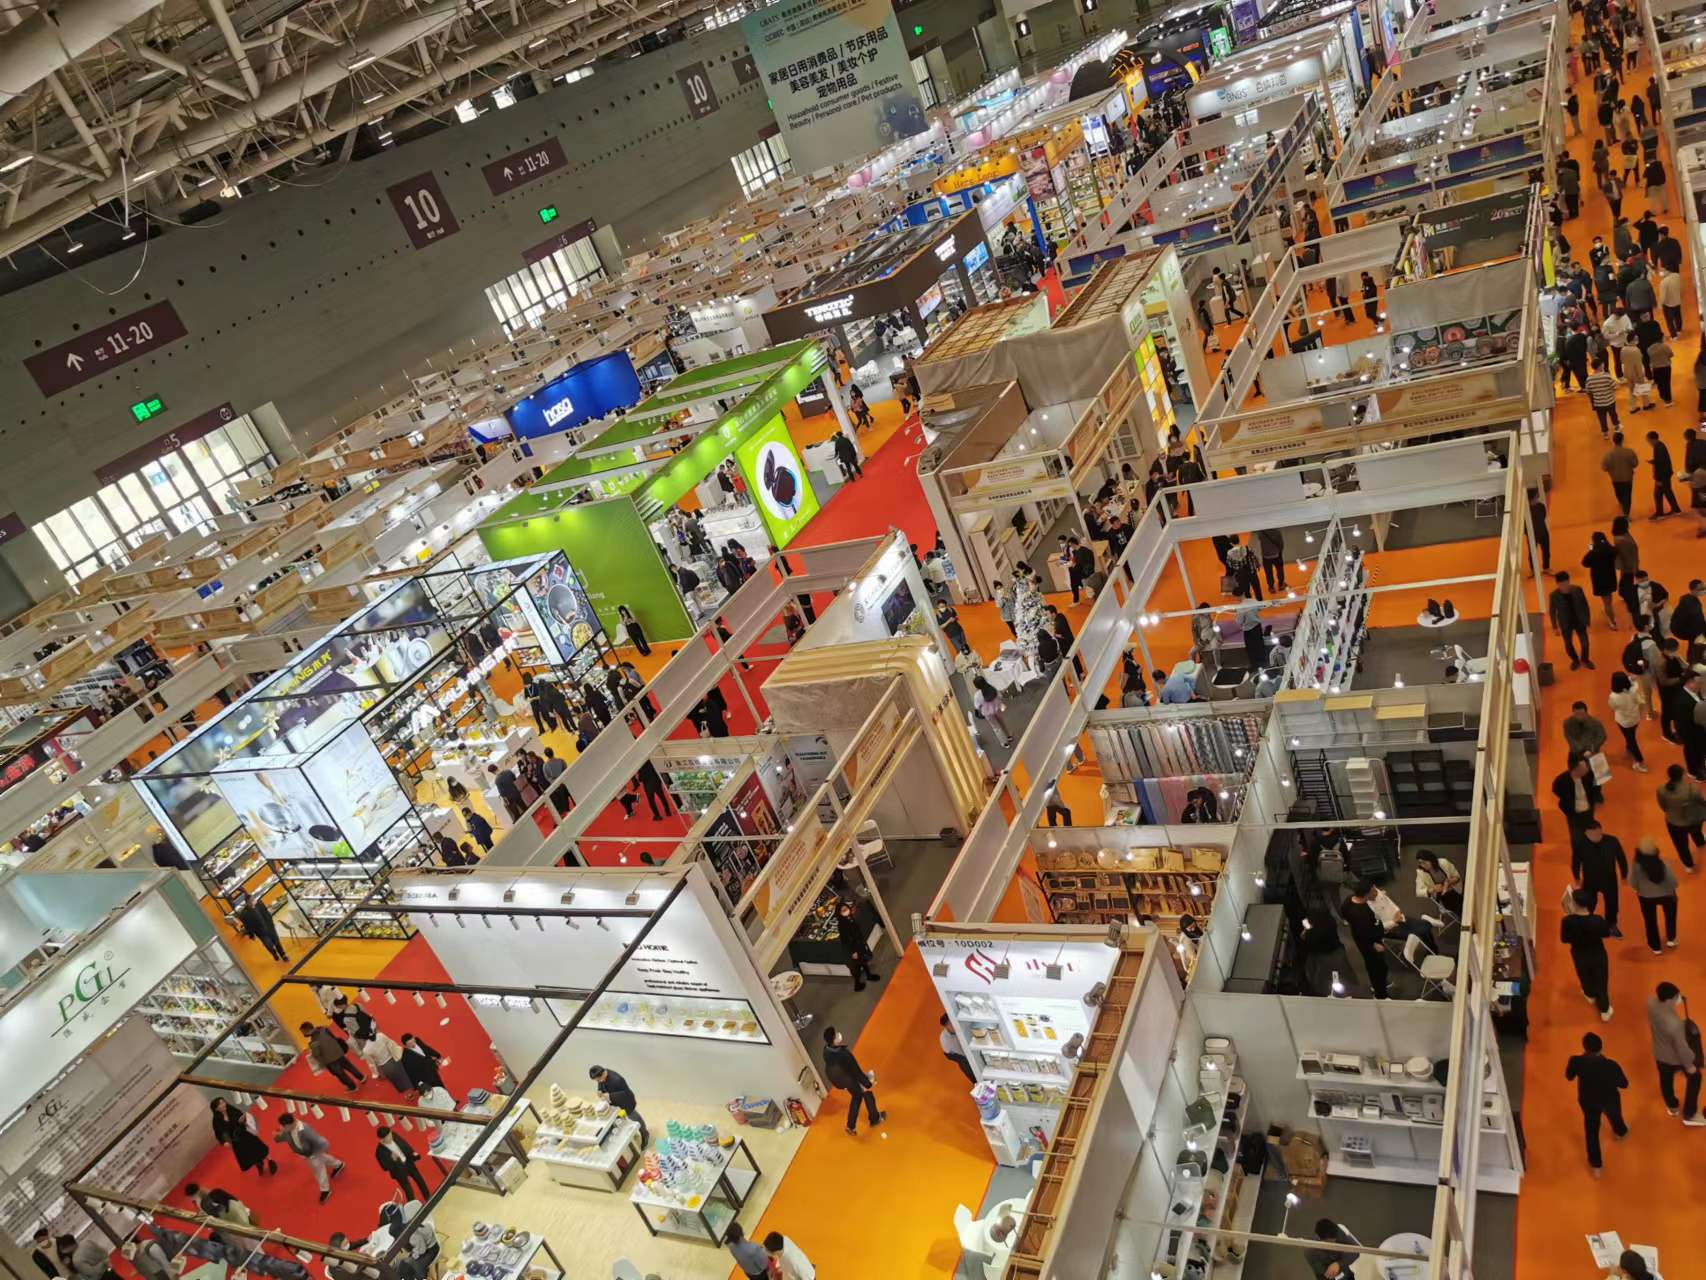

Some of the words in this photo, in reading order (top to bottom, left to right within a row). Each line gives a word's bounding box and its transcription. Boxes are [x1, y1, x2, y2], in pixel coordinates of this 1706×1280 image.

[768, 47, 838, 85] 家居日用消费品
[845, 26, 889, 53] 节庆用品
[789, 68, 830, 94] 美容美发
[838, 47, 878, 74] 美妆个护
[686, 74, 708, 105] 10
[787, 104, 819, 121] Household
[820, 92, 850, 109] consumer
[850, 84, 871, 98] goods
[875, 73, 899, 88] Festive
[816, 73, 858, 98] 宠物用品
[790, 117, 812, 130] Beauty
[815, 104, 842, 120] Personal
[861, 93, 873, 103] Pet
[874, 82, 903, 99] products
[524, 150, 551, 173] 11-20
[404, 188, 441, 231] 10
[561, 234, 568, 246] 6
[107, 321, 153, 354] 11-20
[169, 432, 181, 448] 5
[954, 940, 994, 949] 10D002
